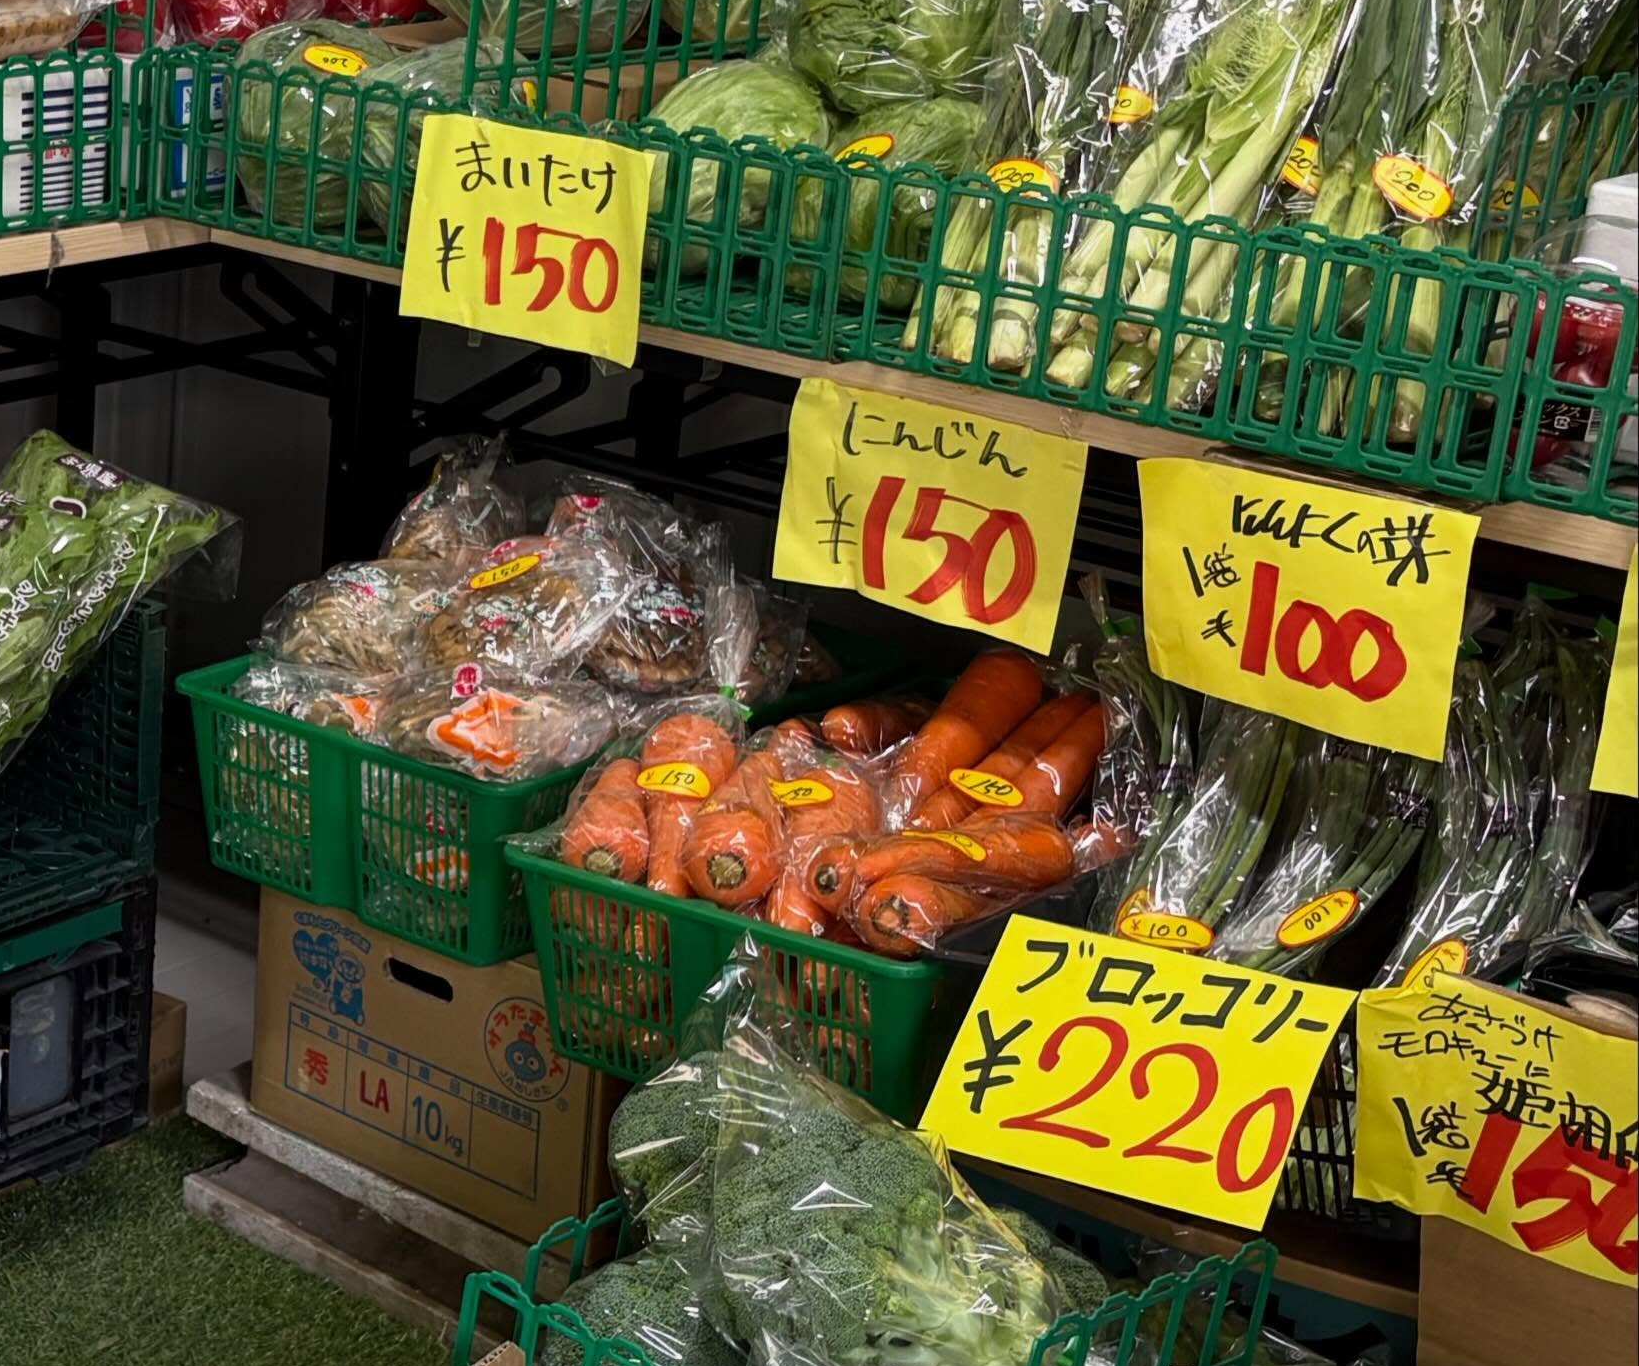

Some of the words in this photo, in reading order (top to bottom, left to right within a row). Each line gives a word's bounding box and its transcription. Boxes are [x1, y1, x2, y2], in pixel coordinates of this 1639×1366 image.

[454, 140, 617, 214] まいたけ
[842, 401, 1028, 478] にんじん
[1016, 939, 1330, 1045] ブロッコリー
[1417, 992, 1564, 1062] あさづけ
[359, 1070, 390, 1114] LA
[962, 1009, 1296, 1193] ¥220
